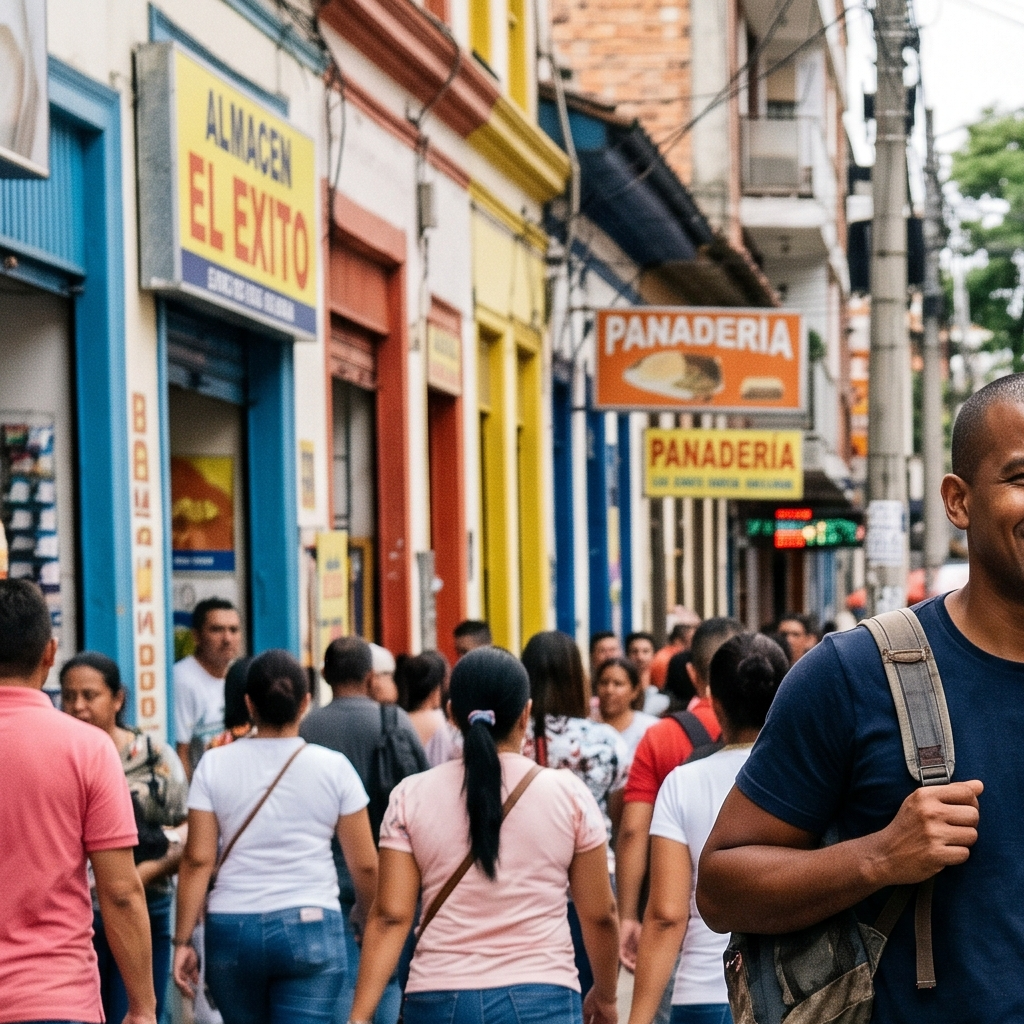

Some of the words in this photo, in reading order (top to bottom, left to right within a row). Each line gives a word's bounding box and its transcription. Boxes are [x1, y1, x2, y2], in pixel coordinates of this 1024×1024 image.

[205, 87, 292, 190] ALMACEN
[188, 149, 224, 252] EL
[232, 174, 309, 291] EXITO
